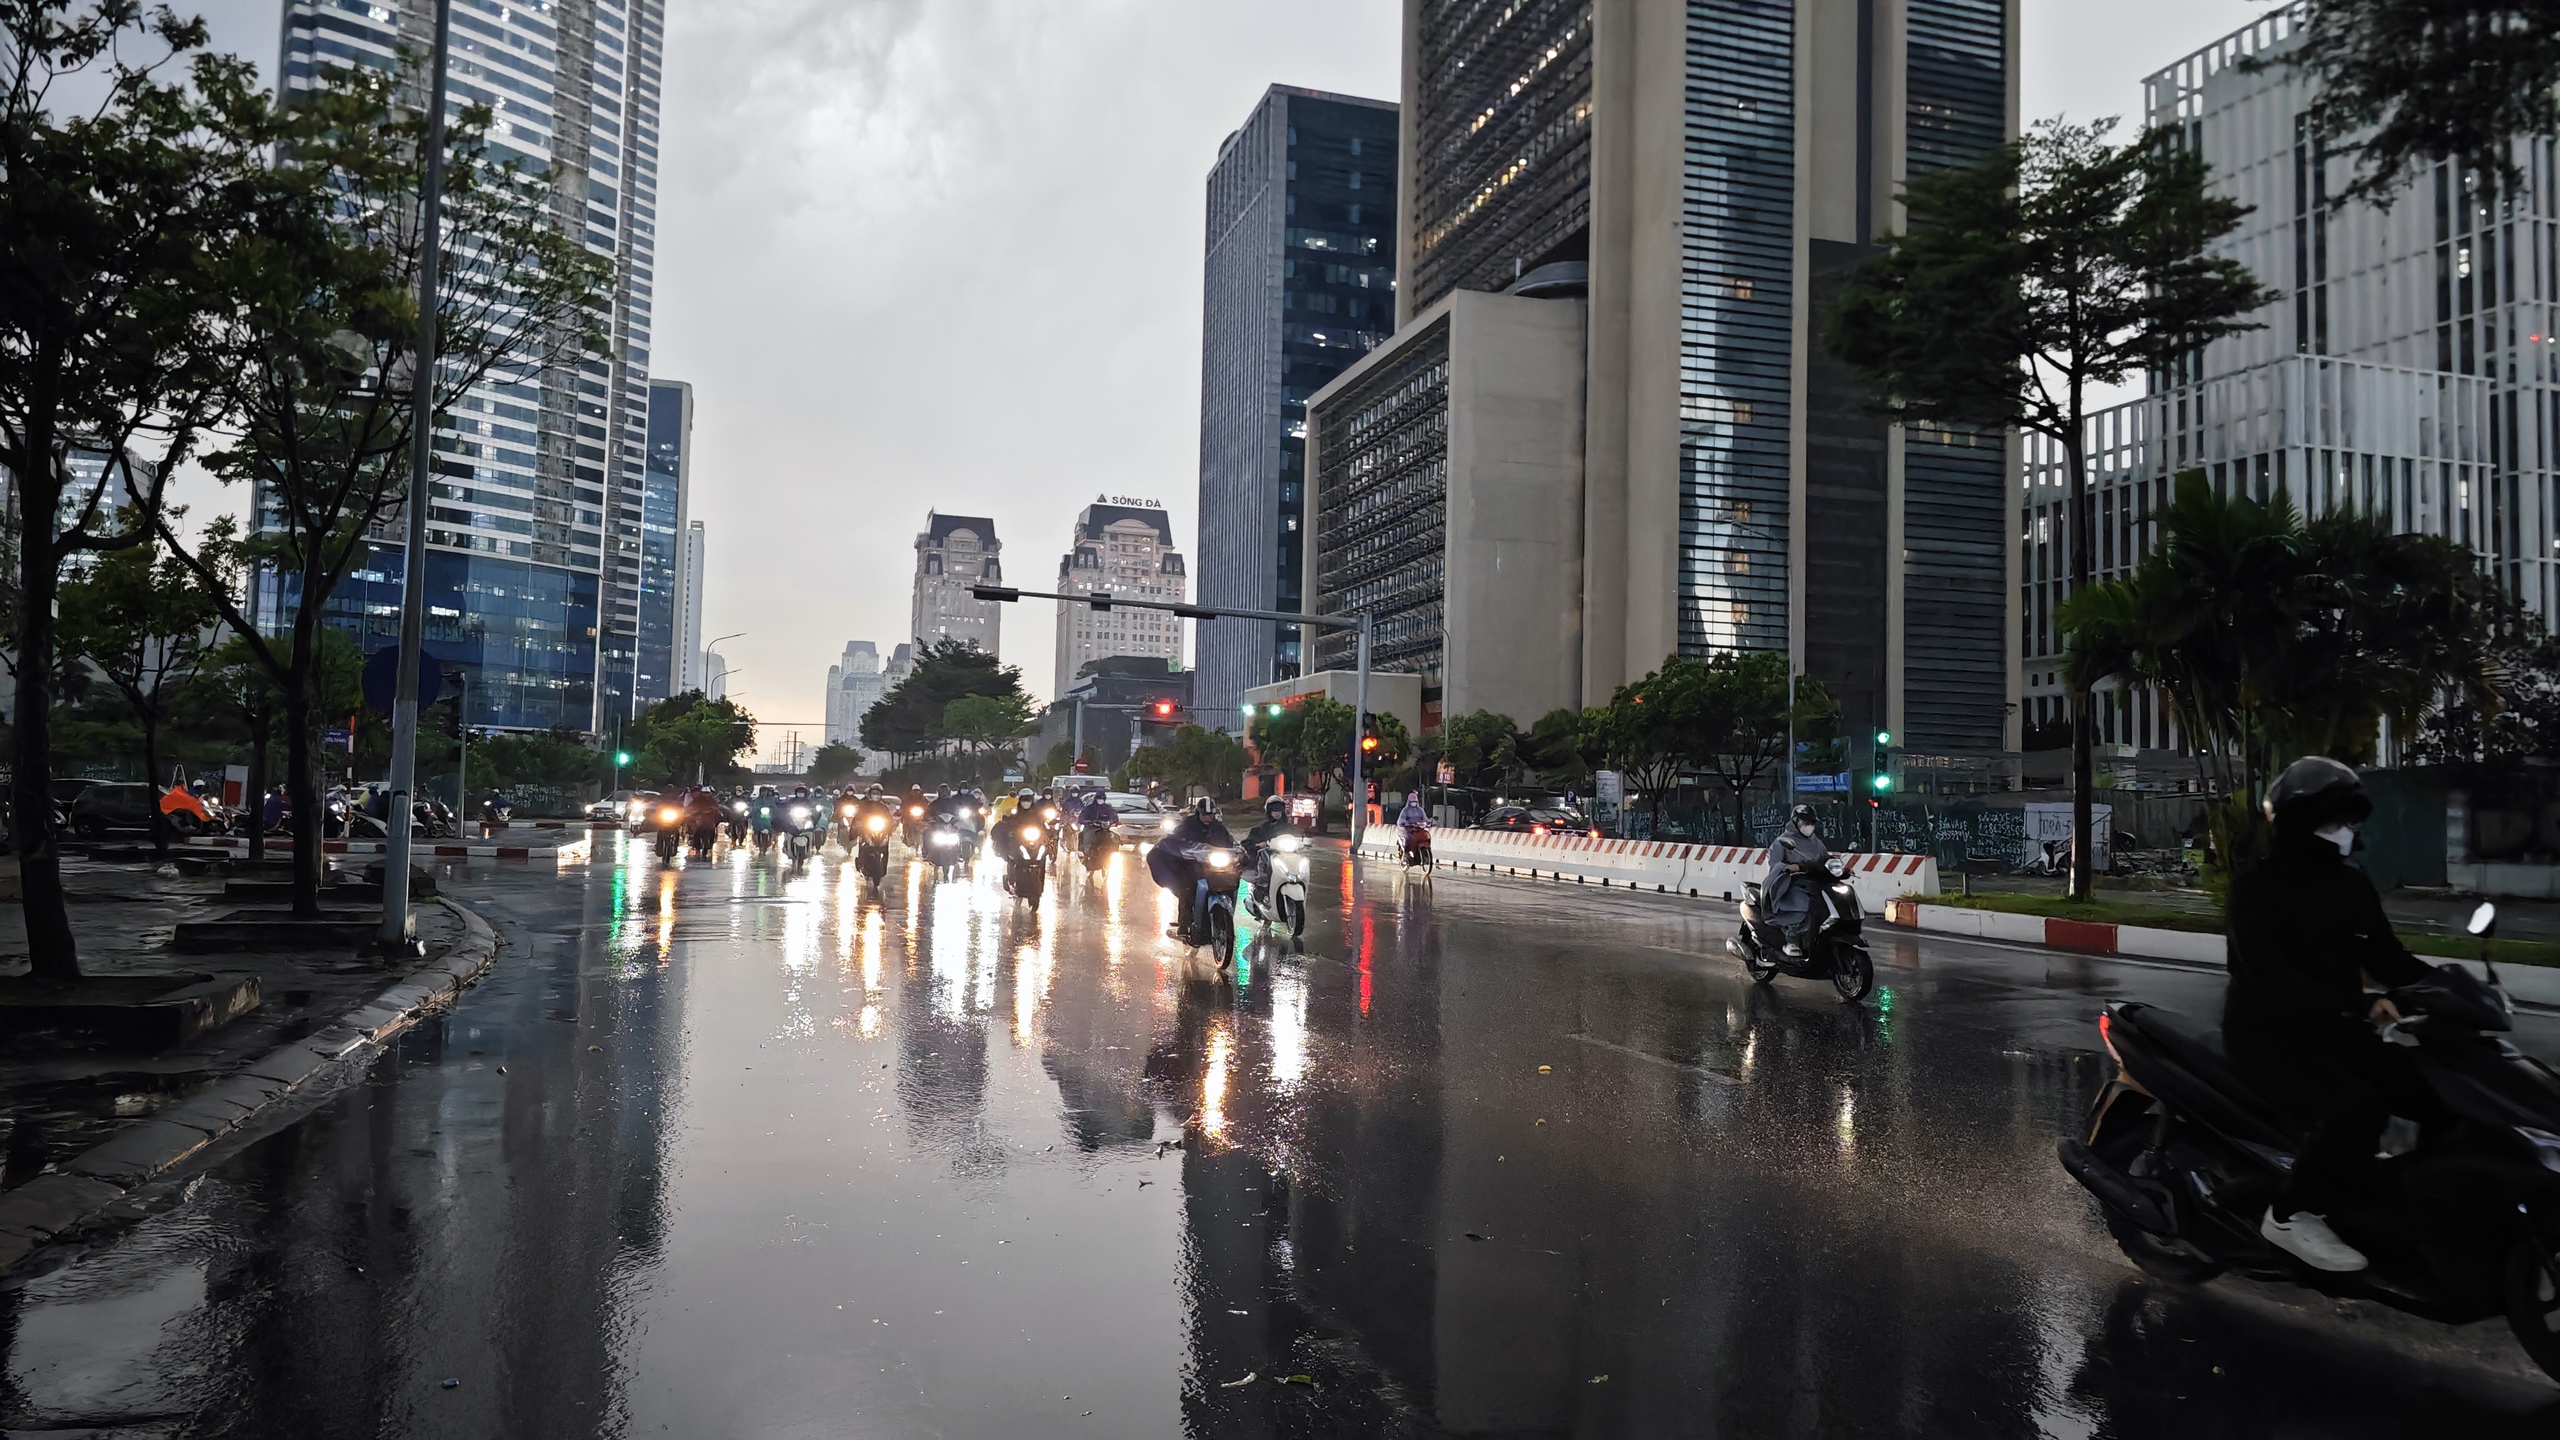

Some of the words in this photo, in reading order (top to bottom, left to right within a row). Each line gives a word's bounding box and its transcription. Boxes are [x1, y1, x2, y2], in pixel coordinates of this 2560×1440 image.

[1112, 495, 1142, 507] SÔNG
[1145, 498, 1161, 508] ĐÀ
[1567, 790, 1575, 802] P
